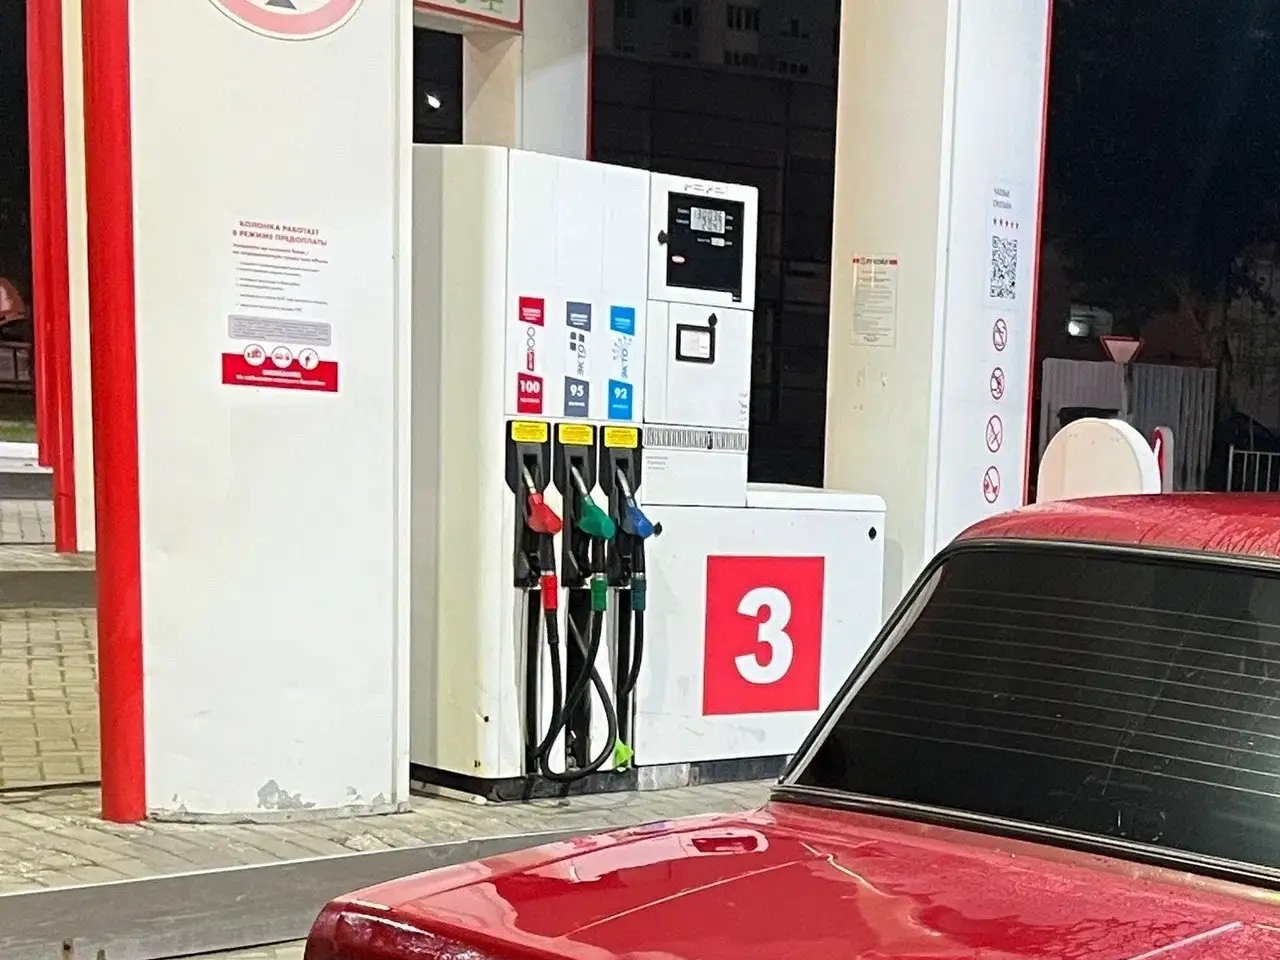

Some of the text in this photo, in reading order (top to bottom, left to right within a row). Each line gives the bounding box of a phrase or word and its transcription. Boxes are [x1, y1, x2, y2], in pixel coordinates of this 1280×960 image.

[275, 234, 327, 246] ПРЕДОПЛАТЫ
[520, 380, 540, 393] 100
[570, 384, 584, 397] 95
[614, 387, 628, 399] 92
[735, 587, 793, 684] 3
